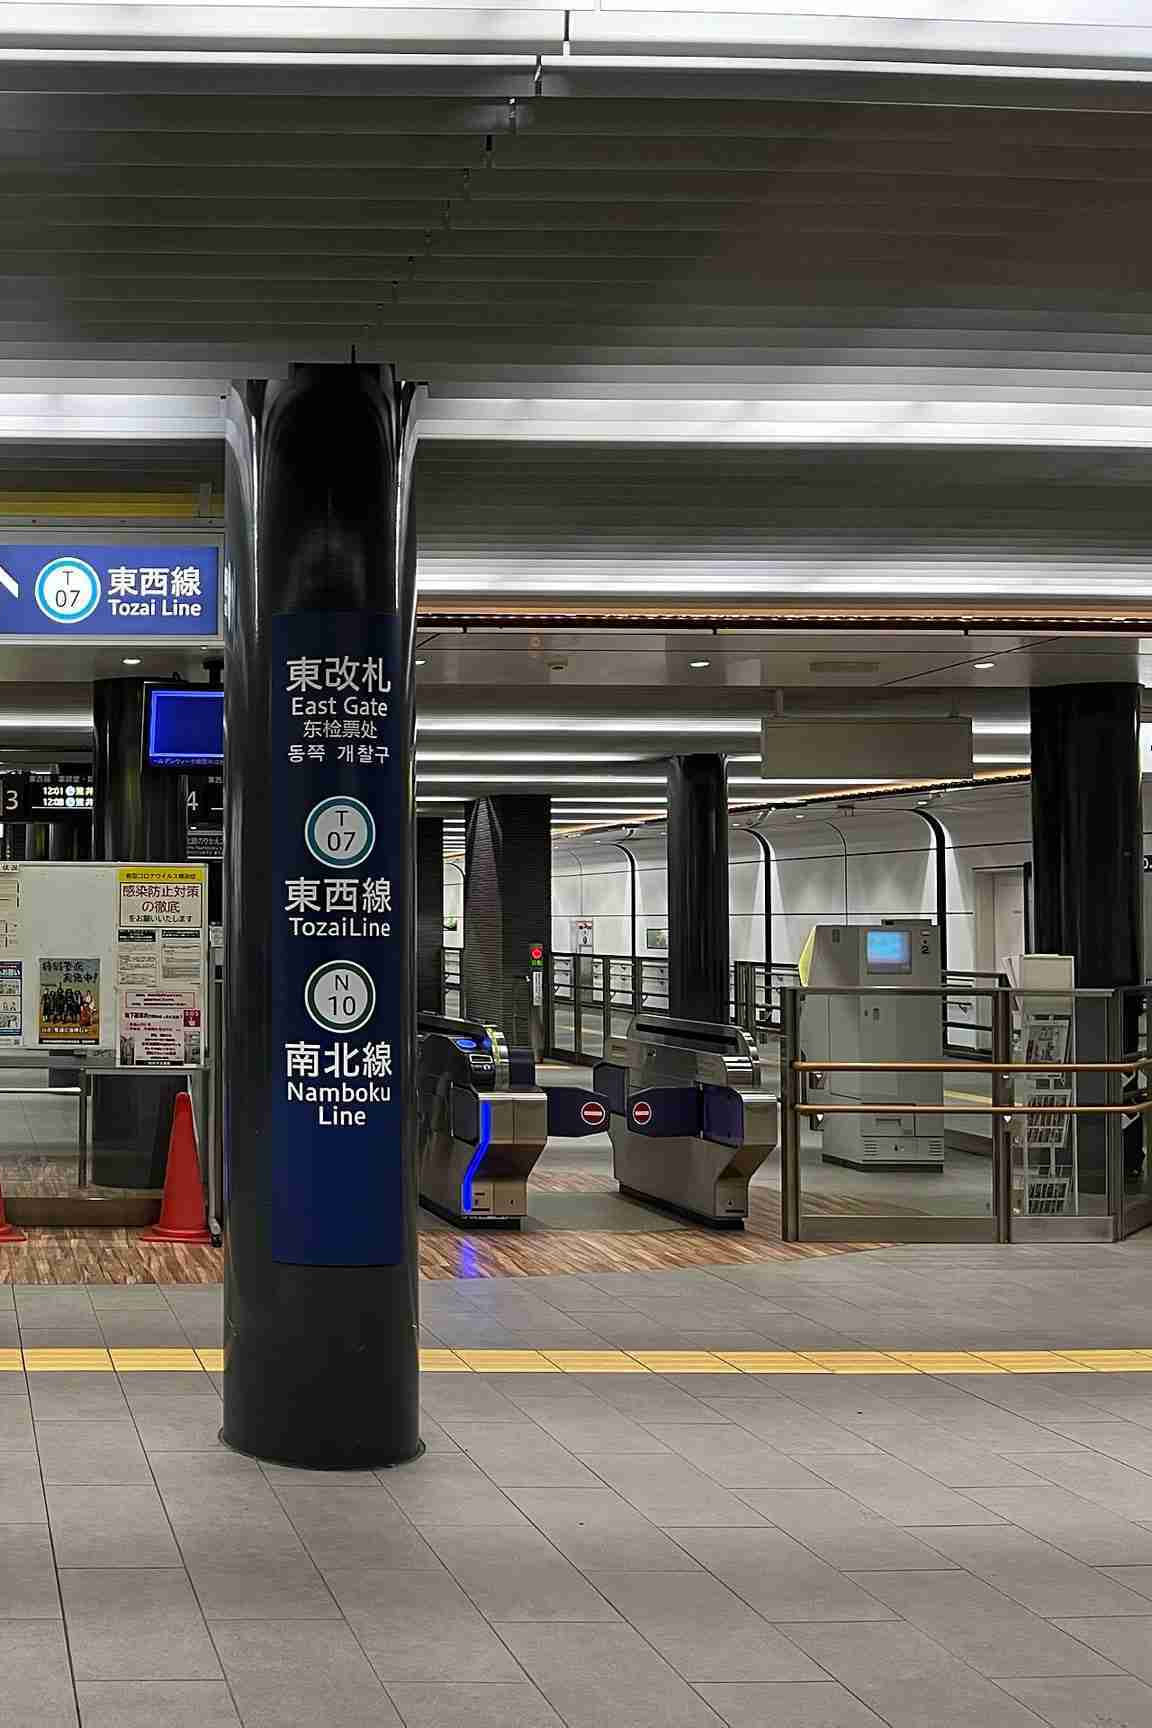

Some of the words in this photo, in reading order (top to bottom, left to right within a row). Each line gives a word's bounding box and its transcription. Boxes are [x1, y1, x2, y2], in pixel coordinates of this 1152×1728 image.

[62, 570, 74, 586] T
[107, 566, 202, 597] 東西線
[55, 589, 81, 608] 07
[108, 599, 156, 617] Tozai
[161, 599, 201, 617] Line
[285, 655, 392, 693] 東改札
[291, 696, 337, 716] East
[343, 697, 388, 717] Gate
[303, 719, 378, 739] 东检票处
[287, 744, 326, 763] 동쪽
[337, 744, 390, 764] 개찰구
[5, 790, 18, 810] 3
[186, 790, 199, 811] 4
[335, 810, 349, 827] T
[327, 831, 356, 852] 07
[123, 885, 200, 898] 感染防止対策
[284, 876, 392, 914] 東西線
[335, 974, 349, 991] N
[328, 995, 356, 1016] 10
[284, 1040, 393, 1079] 南北線
[287, 1081, 391, 1103] Namboku
[318, 1105, 367, 1126] Line
